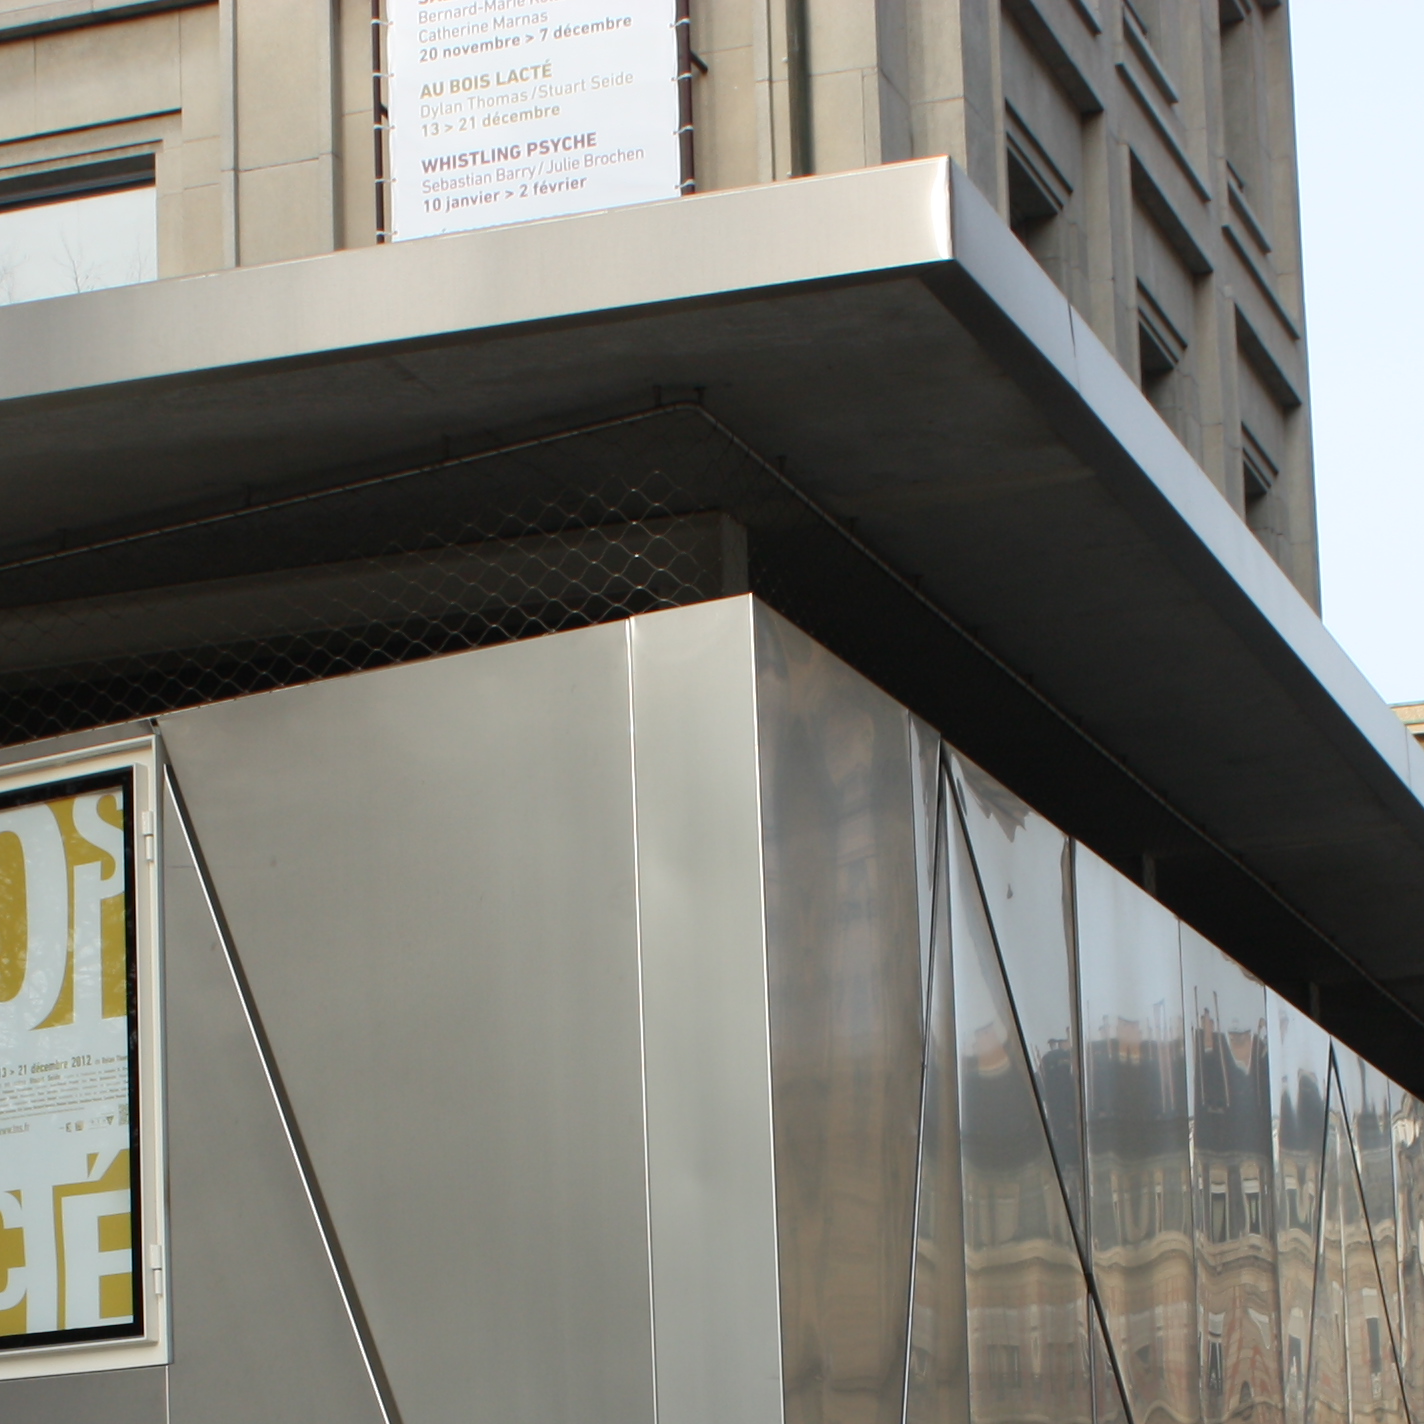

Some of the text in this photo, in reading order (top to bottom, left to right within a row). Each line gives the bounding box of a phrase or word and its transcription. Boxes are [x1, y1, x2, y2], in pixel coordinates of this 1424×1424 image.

[419, 11, 549, 43] Catherine Marnas
[419, 47, 438, 63] 20
[443, 35, 521, 59] novembre
[540, 28, 549, 41] 7
[553, 15, 632, 40] décembre
[420, 59, 553, 99] AU BOIS LACTÉ
[420, 102, 462, 119] Dylan
[467, 91, 528, 110] Thomas
[591, 72, 634, 90] Seide
[421, 122, 440, 137] 13
[459, 116, 476, 131] 21
[482, 105, 560, 127] décembre
[421, 131, 597, 174] WHISTLING PSYCHE
[422, 172, 492, 194] Sebastian
[496, 166, 536, 182] Barry
[546, 157, 580, 175] Julie
[584, 148, 645, 168] Brochen
[424, 197, 442, 213] 10
[445, 191, 500, 214] janvier
[519, 184, 528, 198] 2
[533, 177, 588, 196] février
[18, 1064, 28, 1076] 21
[31, 1060, 68, 1074] décembre
[71, 1054, 92, 1069] 2012
